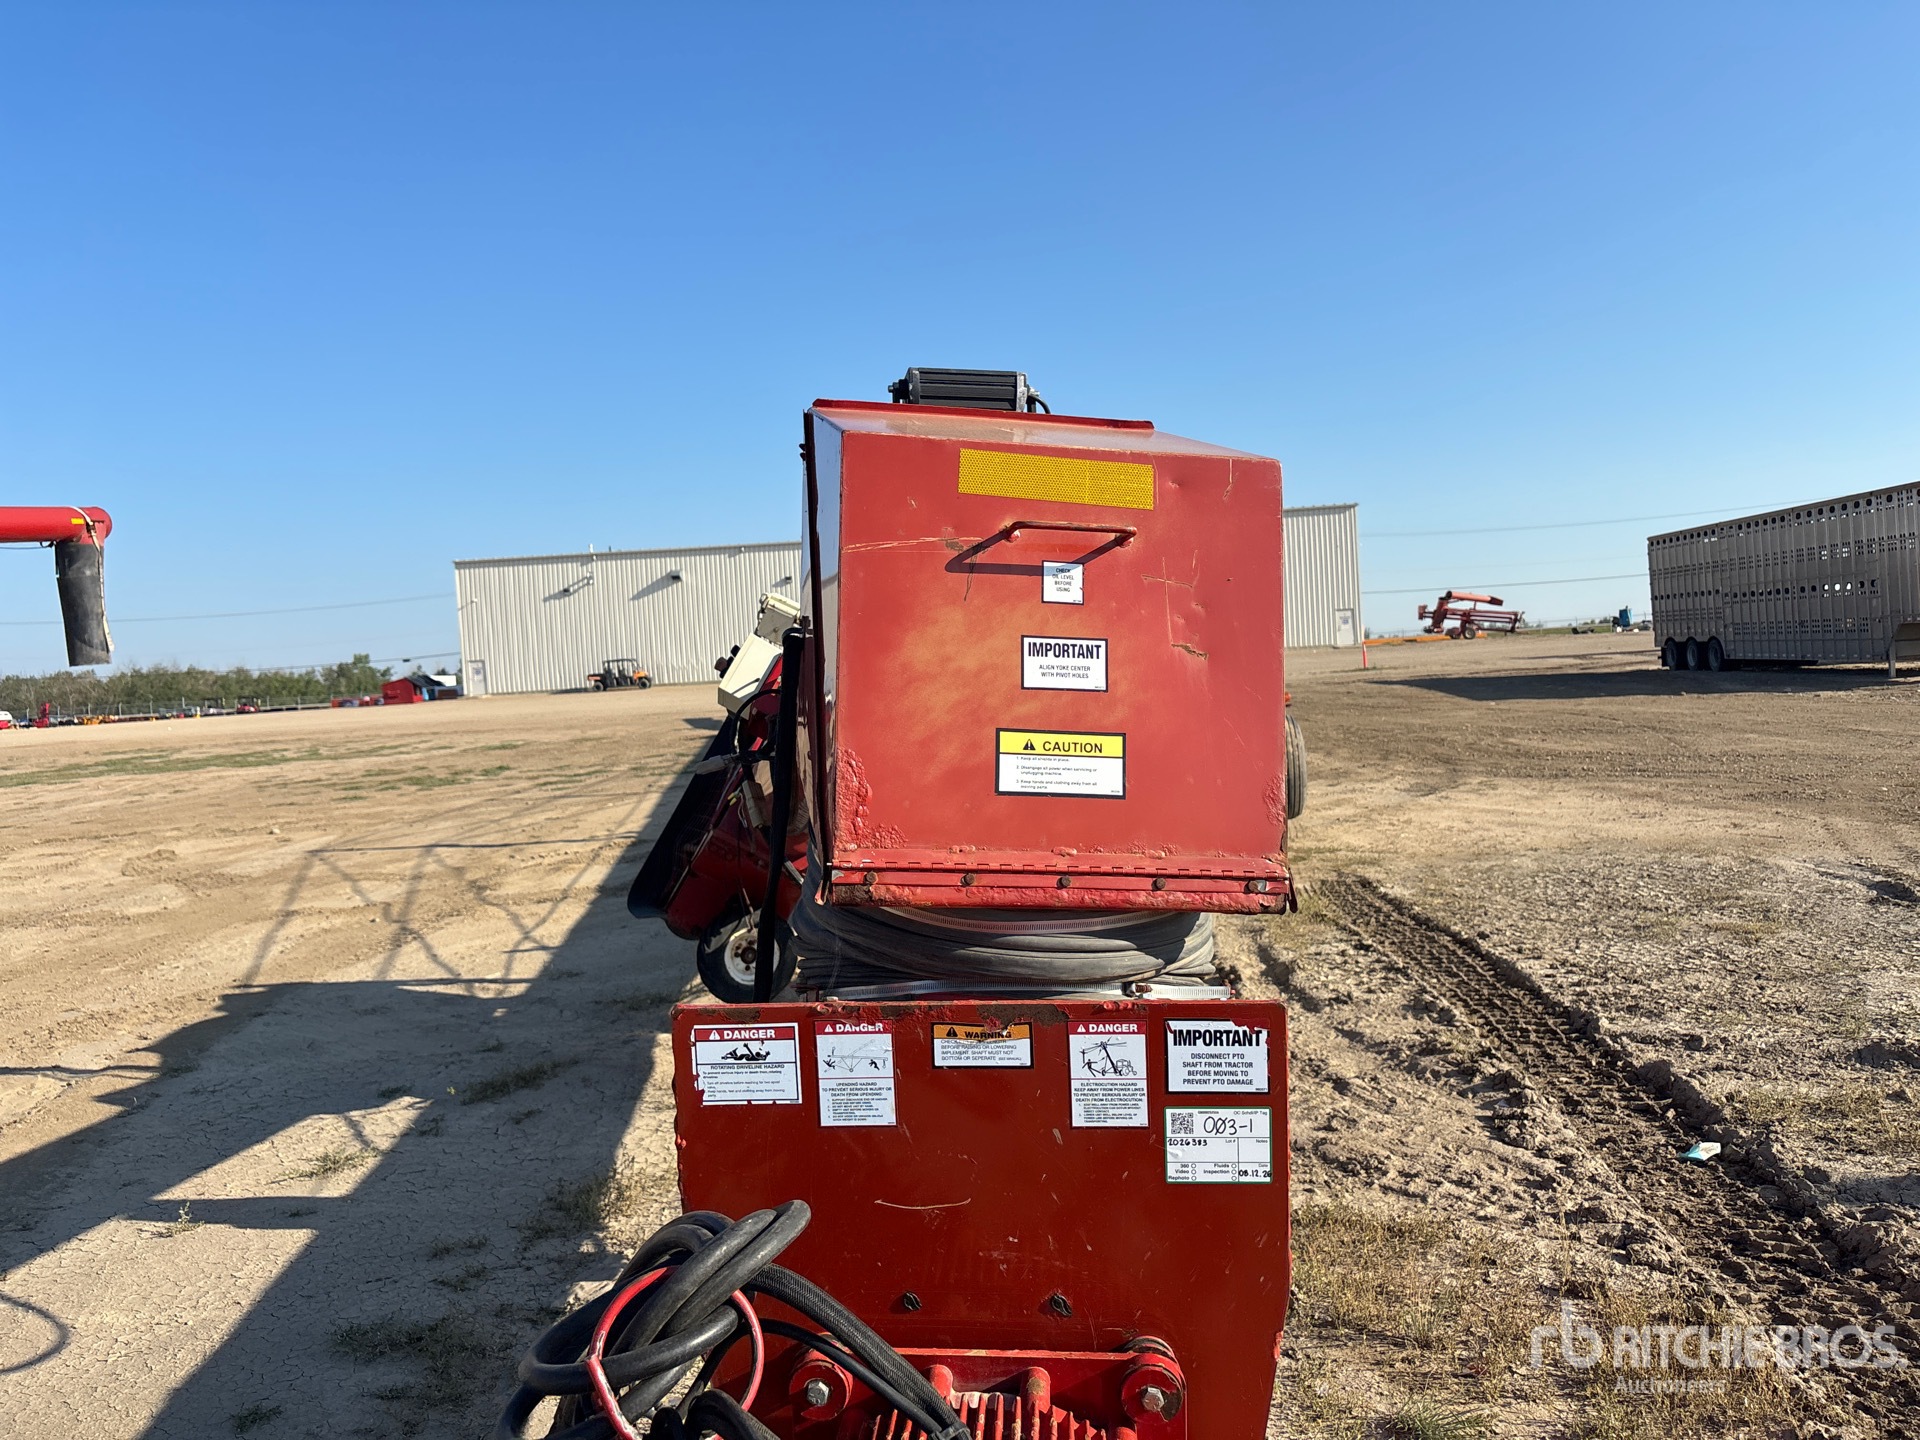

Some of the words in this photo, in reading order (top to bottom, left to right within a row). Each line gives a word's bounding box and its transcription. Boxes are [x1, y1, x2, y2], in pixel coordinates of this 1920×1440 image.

[1028, 642, 1102, 659] IMPORTANT
[1043, 741, 1103, 753] CAUTION
[836, 1023, 883, 1032] DANGER
[1088, 1024, 1138, 1032] DANGER
[724, 1029, 775, 1039] DANGER
[1173, 1029, 1262, 1047] IMPORTANT
